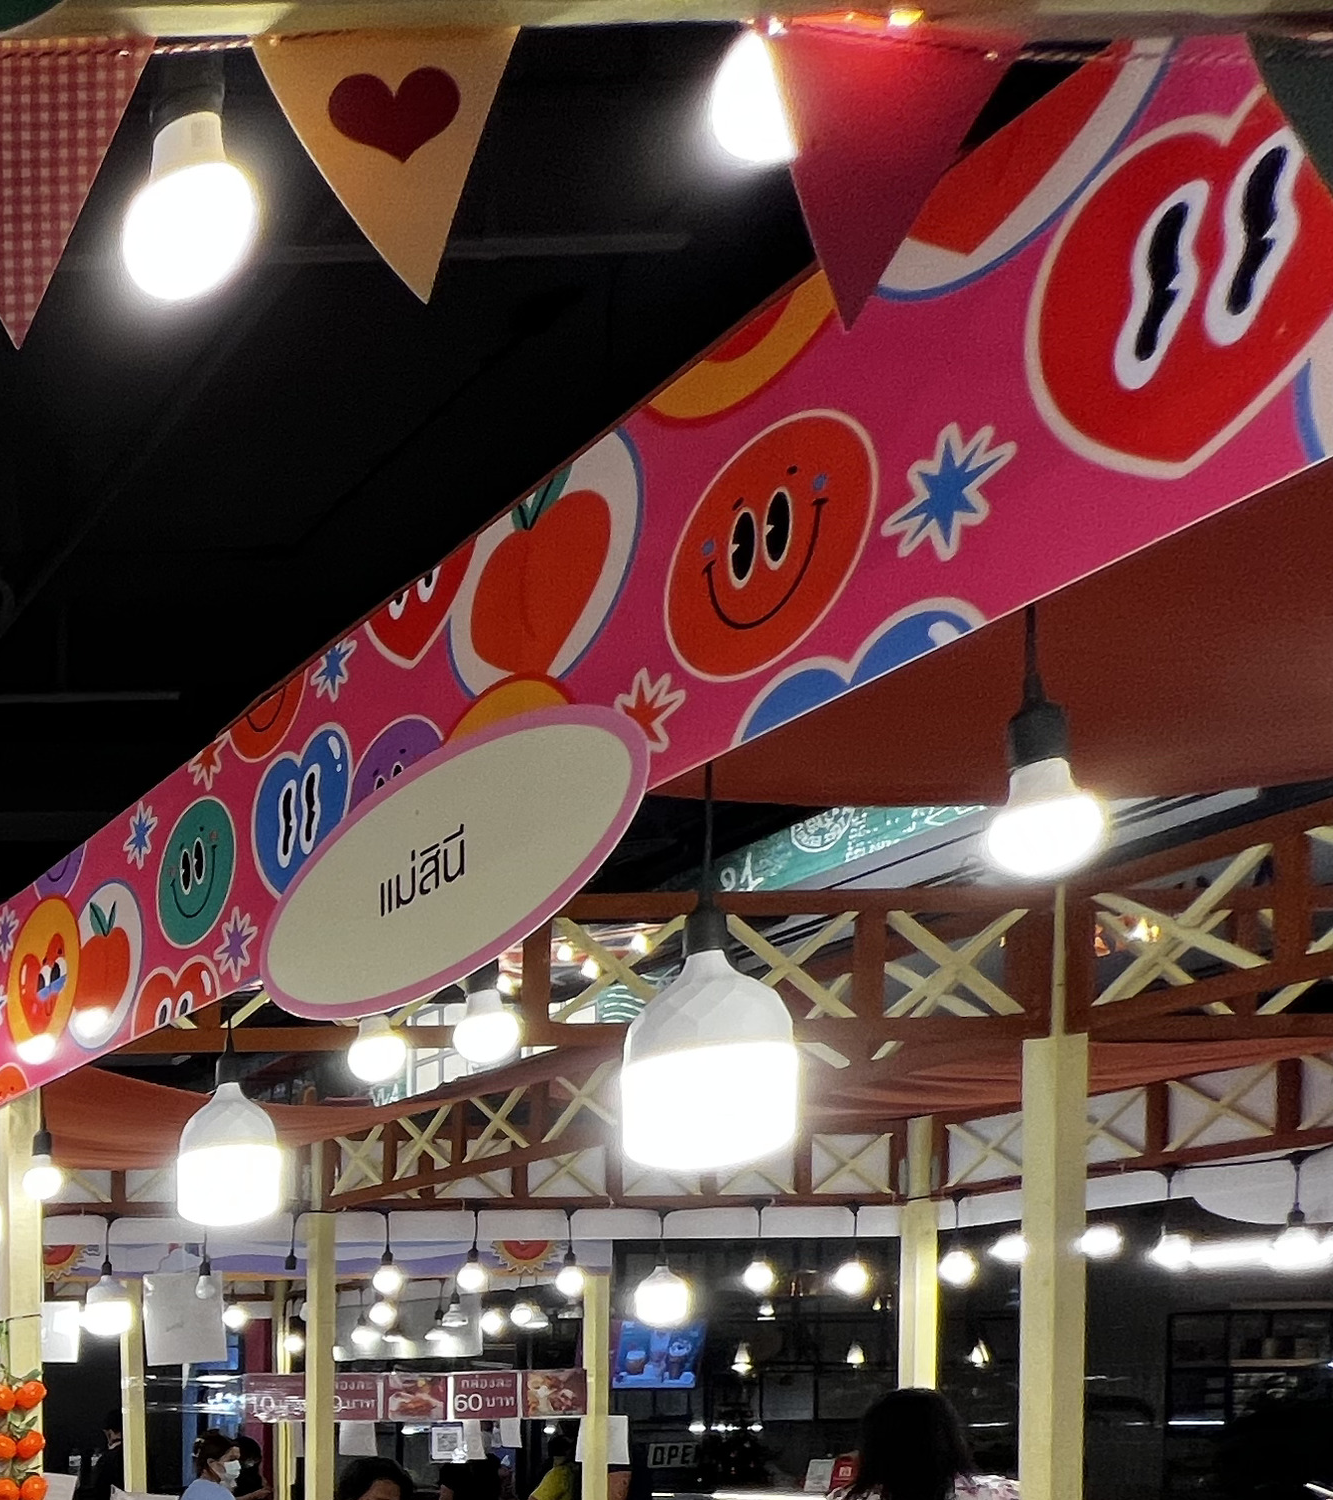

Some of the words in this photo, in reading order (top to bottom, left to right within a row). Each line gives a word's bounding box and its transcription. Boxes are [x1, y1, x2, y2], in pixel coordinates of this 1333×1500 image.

[380, 823, 465, 917] แม่สินี
[454, 1393, 483, 1412] 60
[485, 1396, 515, 1408] บาท
[652, 1445, 699, 1466] OPE
